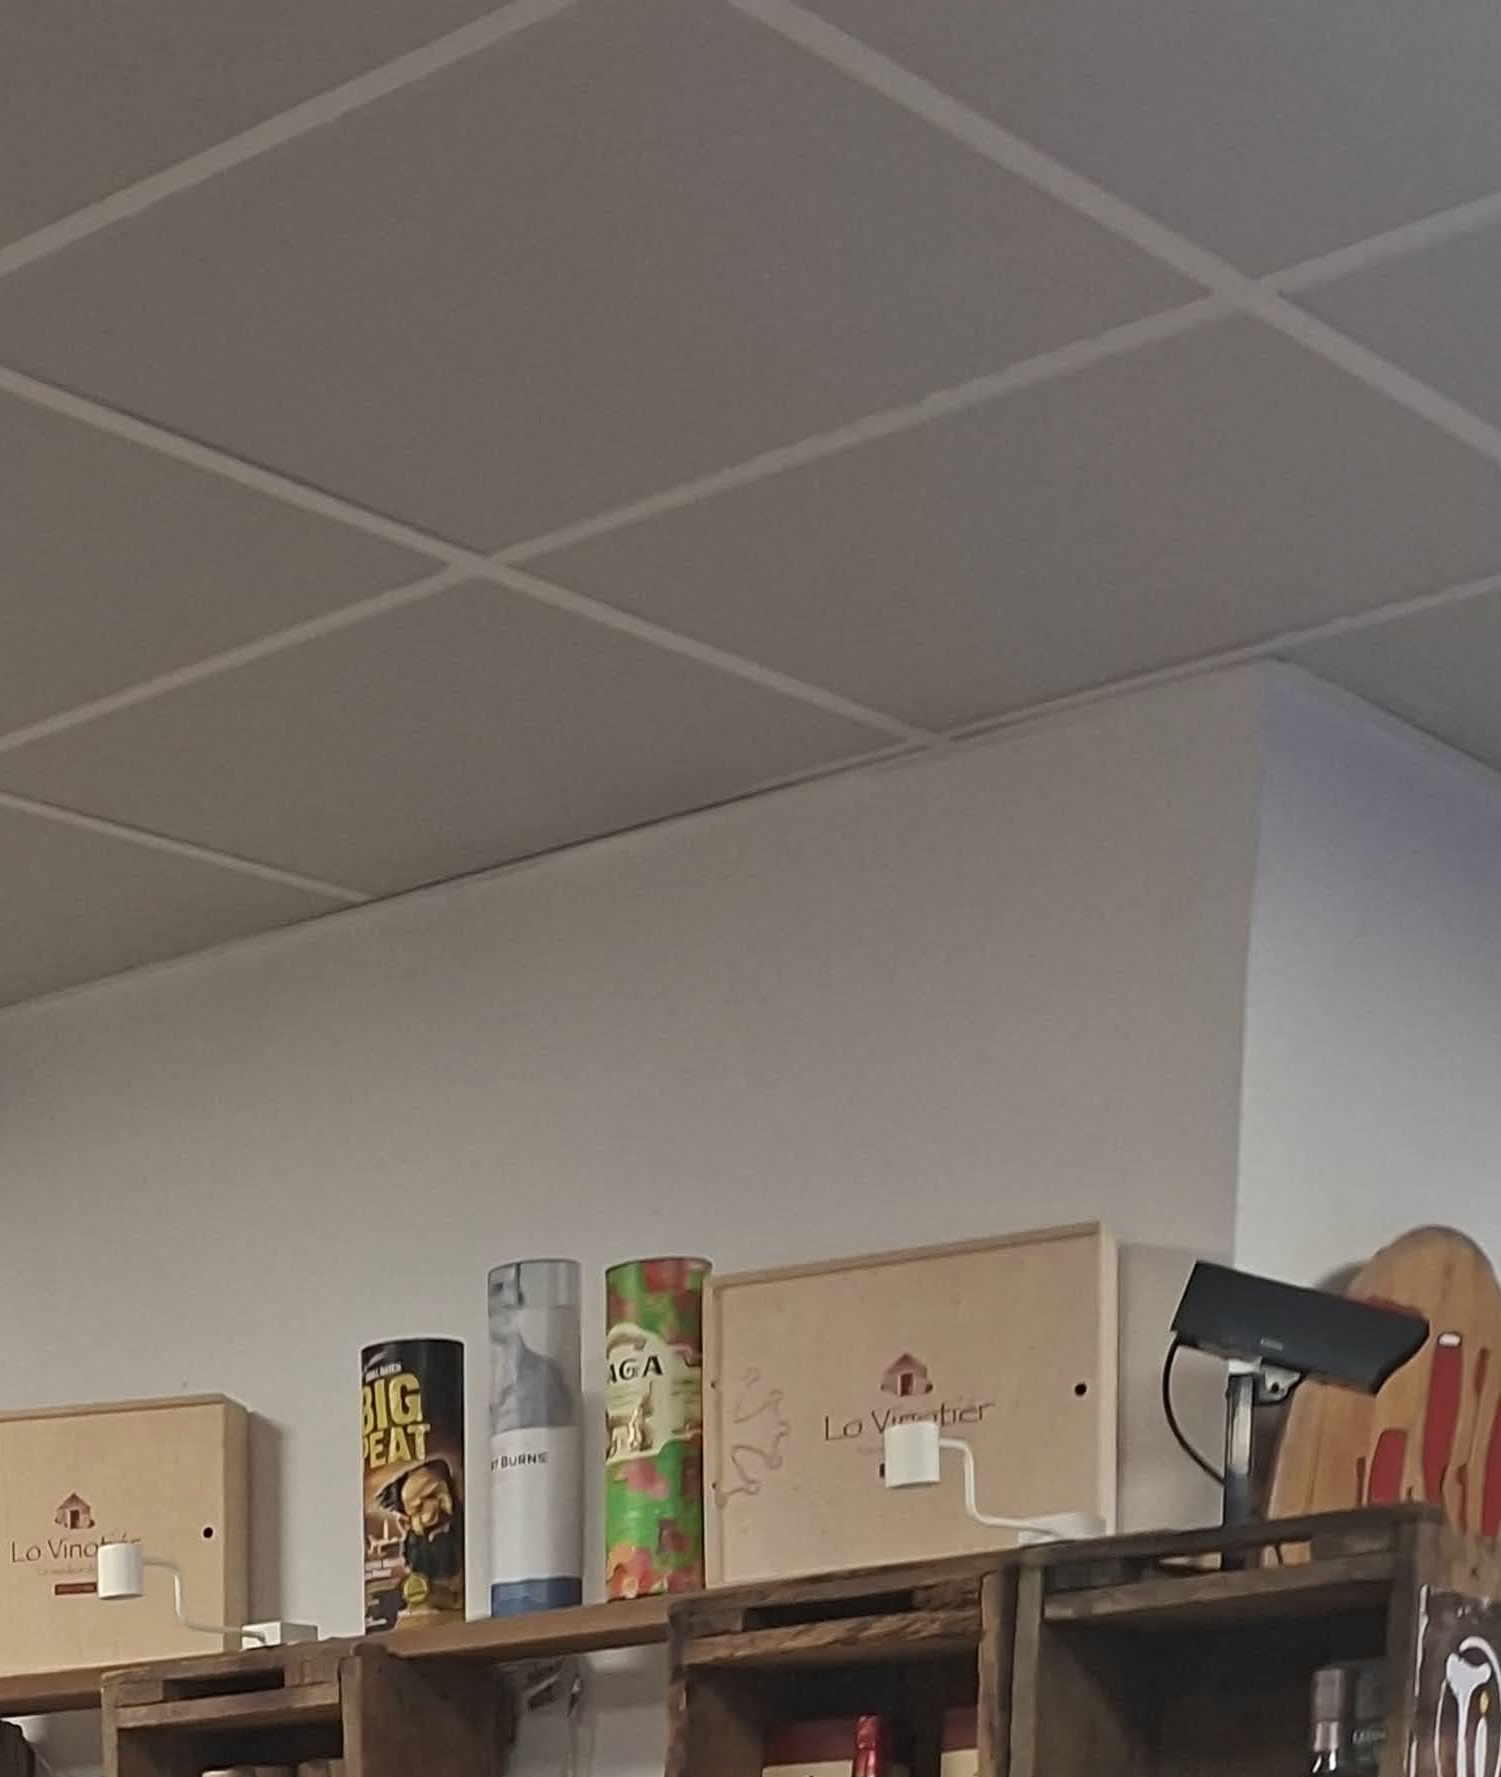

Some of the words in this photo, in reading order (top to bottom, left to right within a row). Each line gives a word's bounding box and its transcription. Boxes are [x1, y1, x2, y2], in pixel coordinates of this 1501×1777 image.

[824, 1415, 863, 1441] Lo
[11, 1540, 42, 1564] Lo
[47, 1533, 142, 1560] Vino
